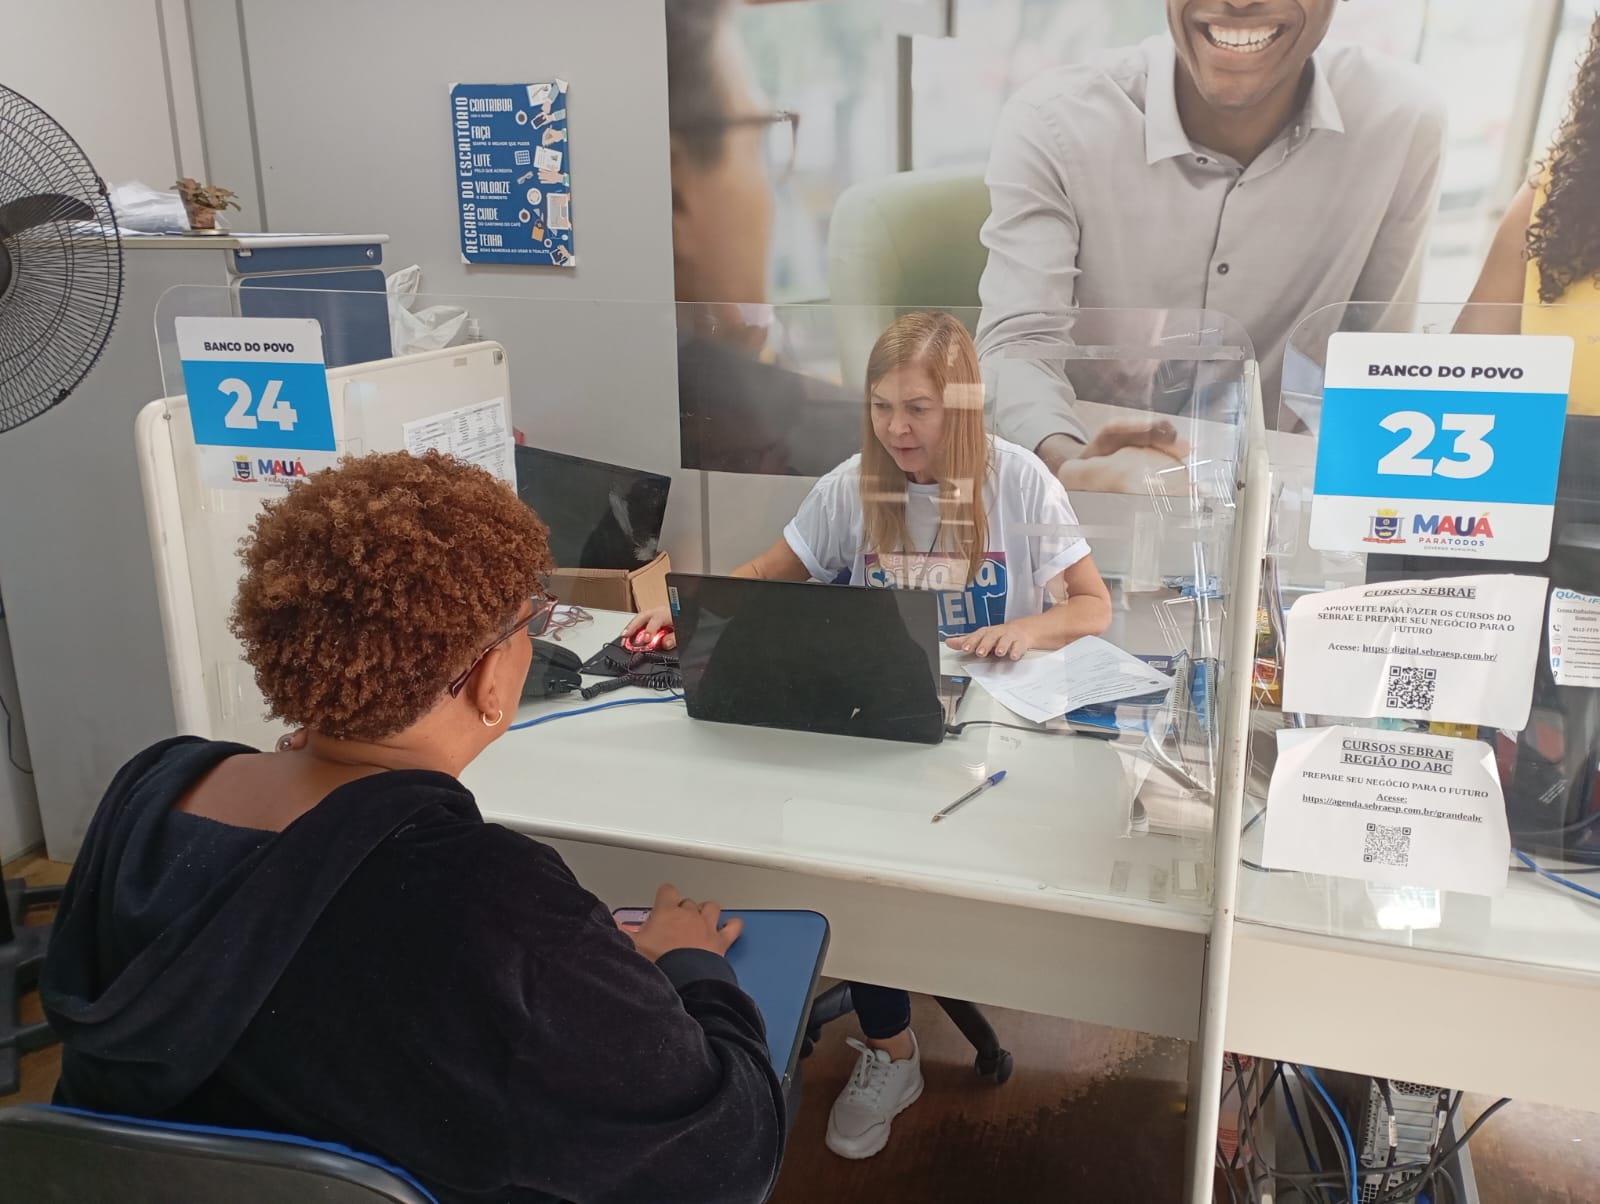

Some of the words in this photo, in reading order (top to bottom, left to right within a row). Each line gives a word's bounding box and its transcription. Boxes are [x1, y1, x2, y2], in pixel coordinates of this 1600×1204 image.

[456, 97, 472, 176] ESCRITÓRIO
[471, 126, 491, 141] FAÇA
[473, 154, 492, 167] LUTE
[461, 181, 474, 199] DO
[475, 181, 511, 194] VALORIZE
[477, 208, 499, 220] CUIDE
[463, 203, 478, 254] REGRAS
[479, 233, 503, 247] TENHA
[204, 341, 242, 352] BANCO
[244, 342, 261, 353] DO
[264, 343, 295, 353] POVO
[1368, 364, 1433, 377] BANCO
[1438, 366, 1466, 378] DO
[1471, 366, 1524, 380] POVO
[217, 377, 298, 431] 24
[1377, 410, 1496, 479] 23
[258, 457, 307, 477] MAUÁ
[1412, 512, 1494, 538] MAUÁ
[1418, 537, 1485, 547] PARATODOS
[1363, 588, 1418, 597] CURSOS
[1420, 587, 1477, 599] SEBRAE
[937, 591, 977, 626] EI
[1323, 605, 1378, 613] APROVEITE
[1380, 606, 1405, 614] PARA
[1406, 607, 1438, 616] FAZER
[1440, 609, 1453, 617] OS
[1455, 611, 1495, 621] CURSOS
[1496, 614, 1512, 622] DO
[1317, 612, 1354, 621] SEBRAE
[1356, 614, 1363, 622] E
[1365, 614, 1408, 624] PREPARE
[1409, 616, 1428, 625] SEU
[1430, 618, 1477, 629] NEGÓCIO
[1479, 622, 1506, 631] PARA
[1506, 624, 1515, 632] O
[1394, 625, 1433, 635] FUTURO
[1328, 642, 1360, 652] Acesse:
[1342, 739, 1396, 755] CURSOS
[1400, 744, 1454, 761] SEBRAE
[1343, 753, 1398, 769] REGIÃO
[1401, 758, 1421, 770] DO
[1424, 762, 1453, 775] ABC
[1302, 771, 1345, 782] PREPARE
[1346, 775, 1364, 784] SEU
[1365, 778, 1410, 789] NEGÓCIO
[1411, 783, 1437, 792] PARA
[1448, 788, 1489, 798] FUTURO
[1376, 793, 1408, 804] Acesse:
